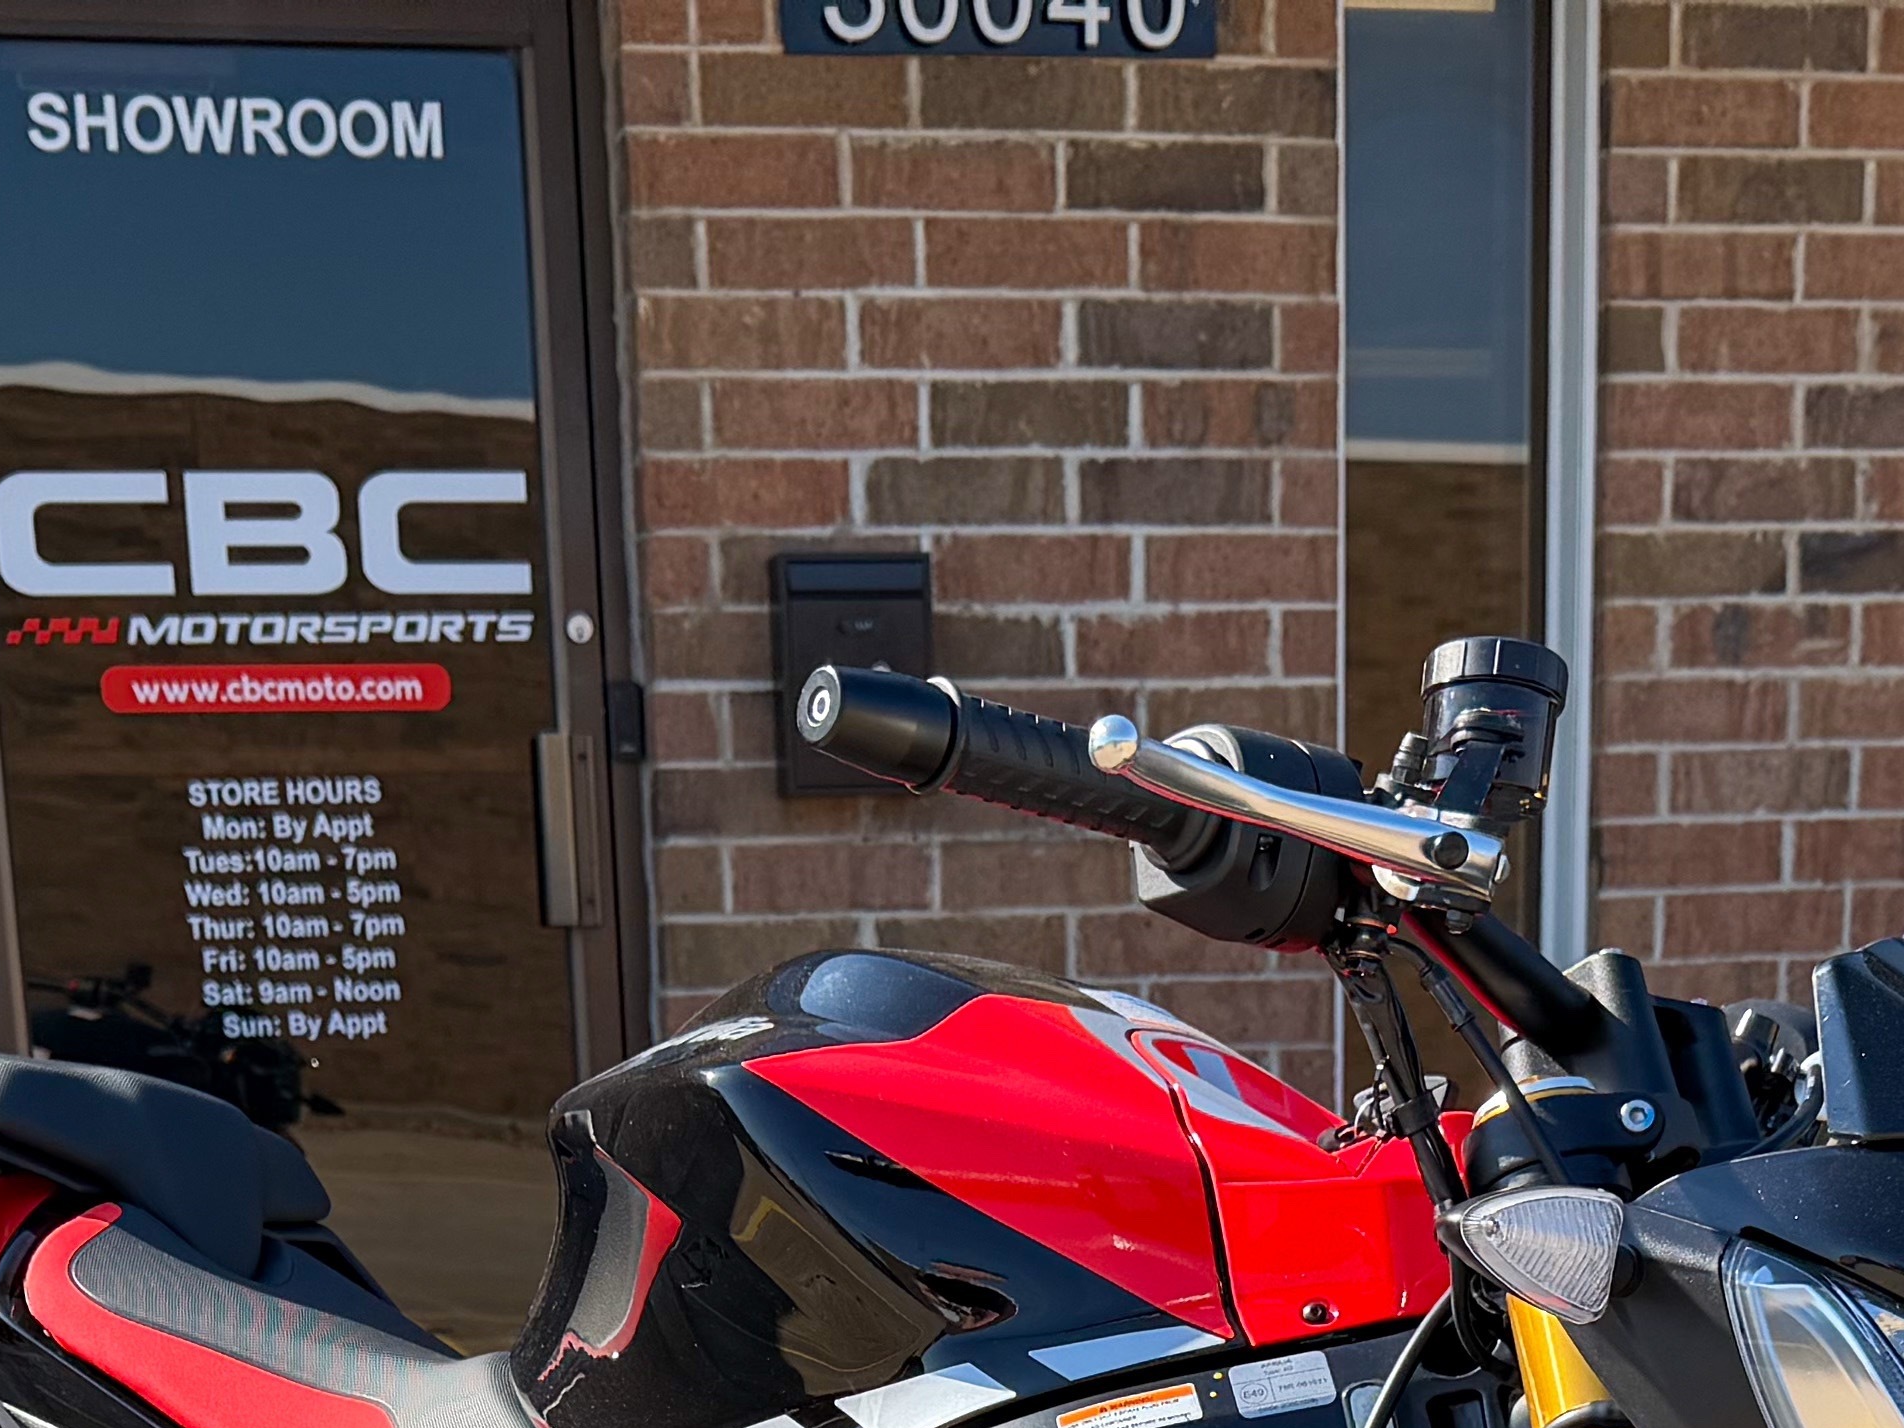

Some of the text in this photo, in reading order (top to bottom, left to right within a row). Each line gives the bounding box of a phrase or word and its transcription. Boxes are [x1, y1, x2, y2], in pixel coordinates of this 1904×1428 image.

[28, 93, 443, 158] SHOWROOM
[128, 614, 534, 645] MOTORSPORTS
[132, 675, 422, 703] www.cbcmoto.com
[188, 776, 382, 807] STORE HOURS
[201, 811, 374, 844] Mon: By Appt
[341, 844, 397, 875] 7pm
[184, 878, 401, 908] Wed: 10am - 5pm
[187, 911, 405, 941] Thur: 10am - 7pm
[202, 944, 396, 974] Fri: 10am - 5pm
[202, 976, 401, 1006] Sat: 9am - Noon
[222, 1009, 387, 1041] Sun: By Appt
